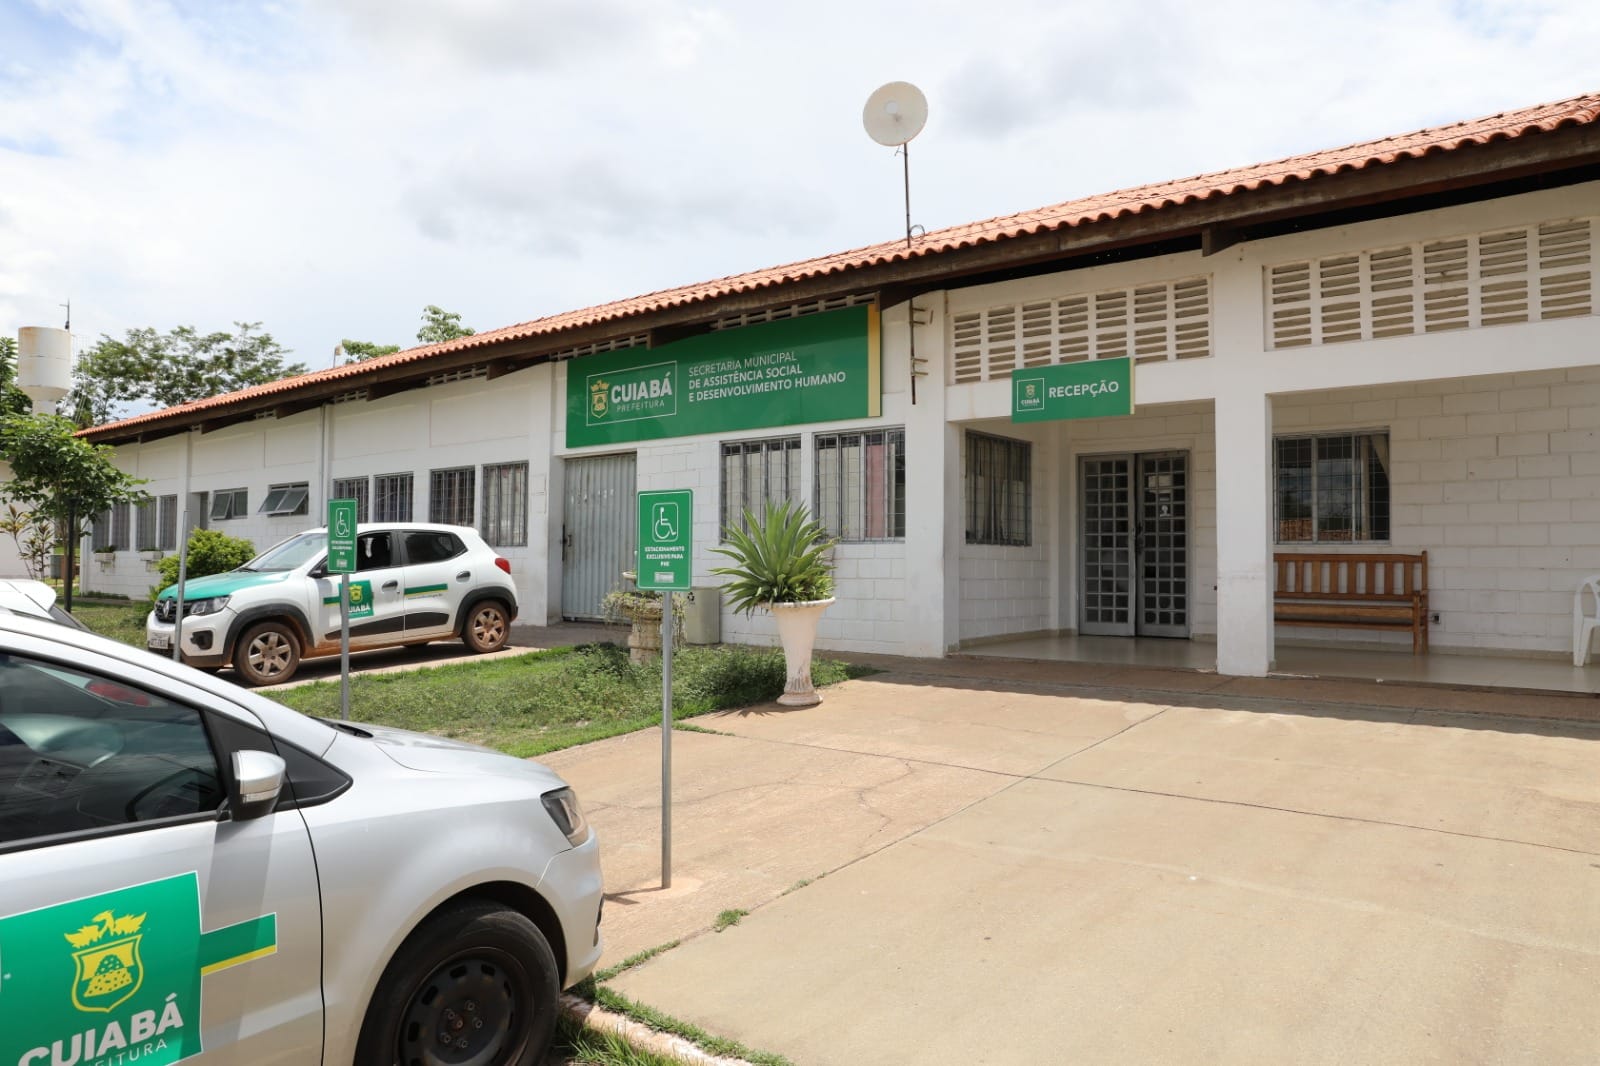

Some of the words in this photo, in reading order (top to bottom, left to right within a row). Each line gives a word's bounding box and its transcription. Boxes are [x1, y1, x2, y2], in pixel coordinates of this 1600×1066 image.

[689, 360, 741, 377] SECRETARIA
[744, 351, 797, 368] MUNICIPAL
[689, 379, 701, 390] DE
[703, 369, 763, 387] ASSISTÊNCIA
[766, 363, 803, 378] SOCIAL
[611, 371, 672, 404] CUIABÁ
[689, 392, 695, 402] E
[697, 379, 792, 401] DESENVOLVIMENTO
[794, 371, 846, 388] HUMANO
[1048, 380, 1119, 398] RECEPÇÃO
[616, 400, 665, 413] PREFEITURA
[18, 992, 184, 1066] CUIABÁ
